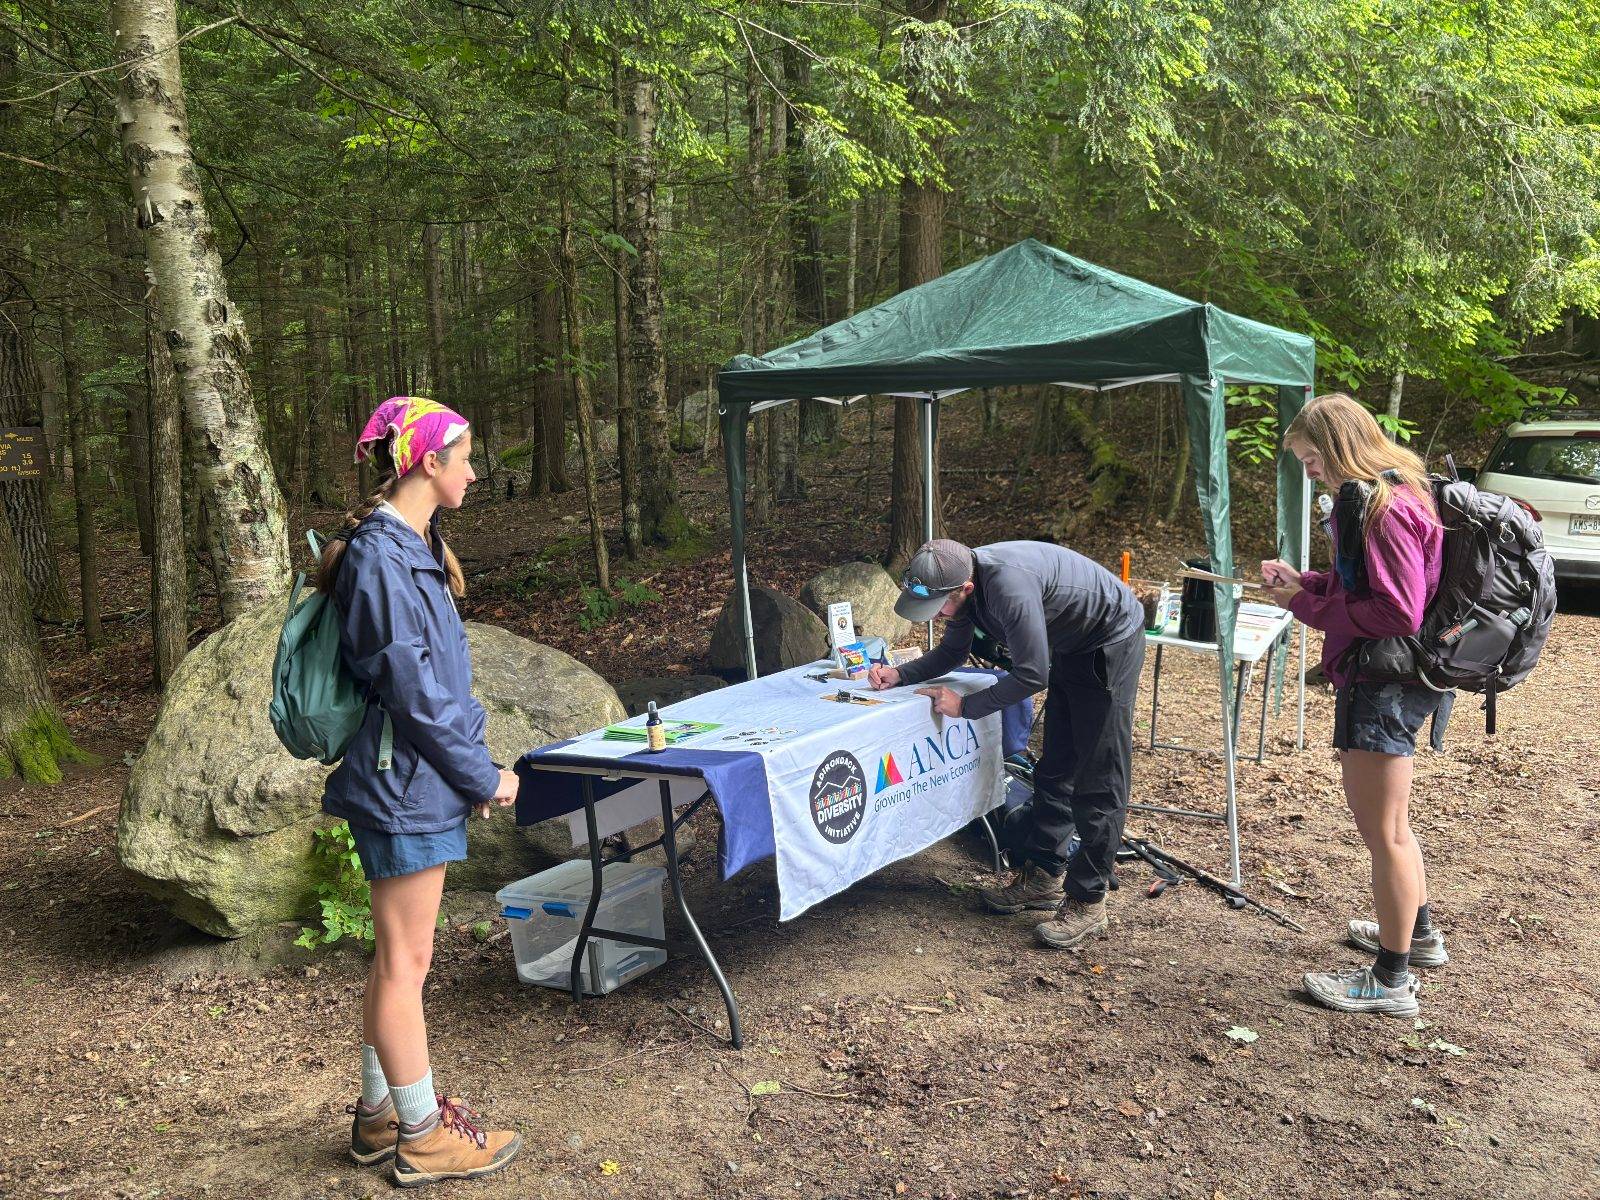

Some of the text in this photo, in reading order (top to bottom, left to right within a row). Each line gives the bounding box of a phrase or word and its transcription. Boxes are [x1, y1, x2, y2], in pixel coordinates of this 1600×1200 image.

[907, 719, 981, 781] ANCA
[816, 756, 857, 788] ADIRONDACK
[874, 756, 981, 812] Growing The New Economy
[817, 793, 862, 824] DIVERSITY
[824, 811, 861, 838] INITIATIVE
